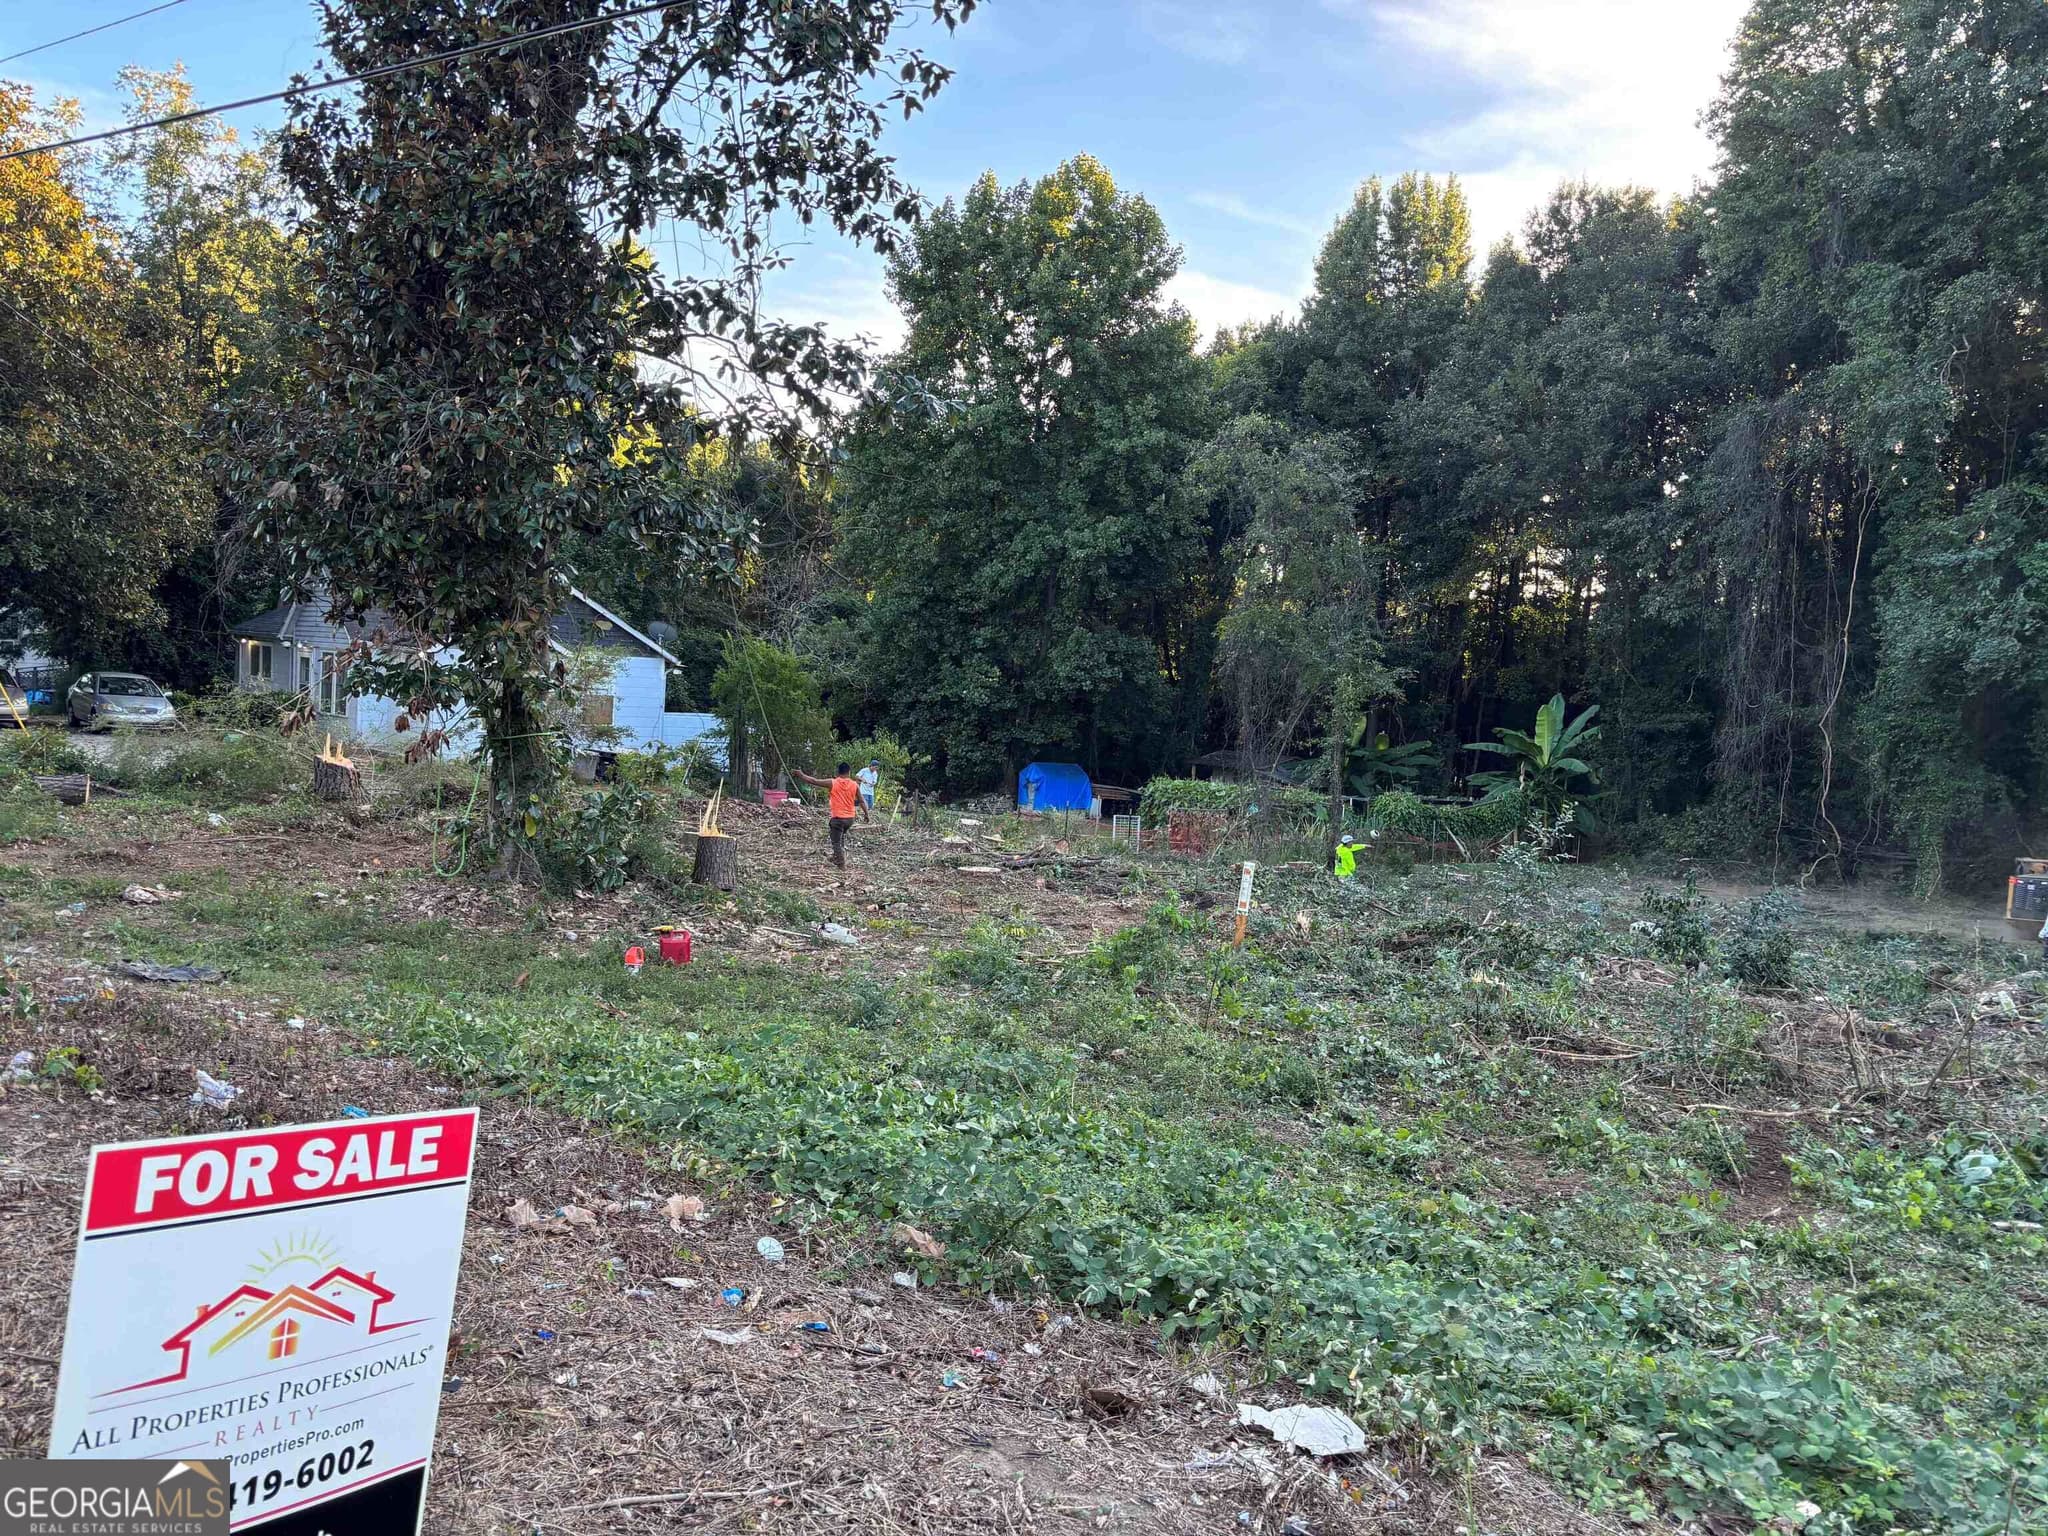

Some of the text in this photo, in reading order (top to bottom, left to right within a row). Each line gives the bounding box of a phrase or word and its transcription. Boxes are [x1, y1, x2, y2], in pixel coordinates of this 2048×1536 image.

[134, 1126, 442, 1214] FOR SALE
[70, 1429, 121, 1455] ALL
[131, 1391, 269, 1440] PROPERTIES
[214, 1404, 319, 1447] REALTY
